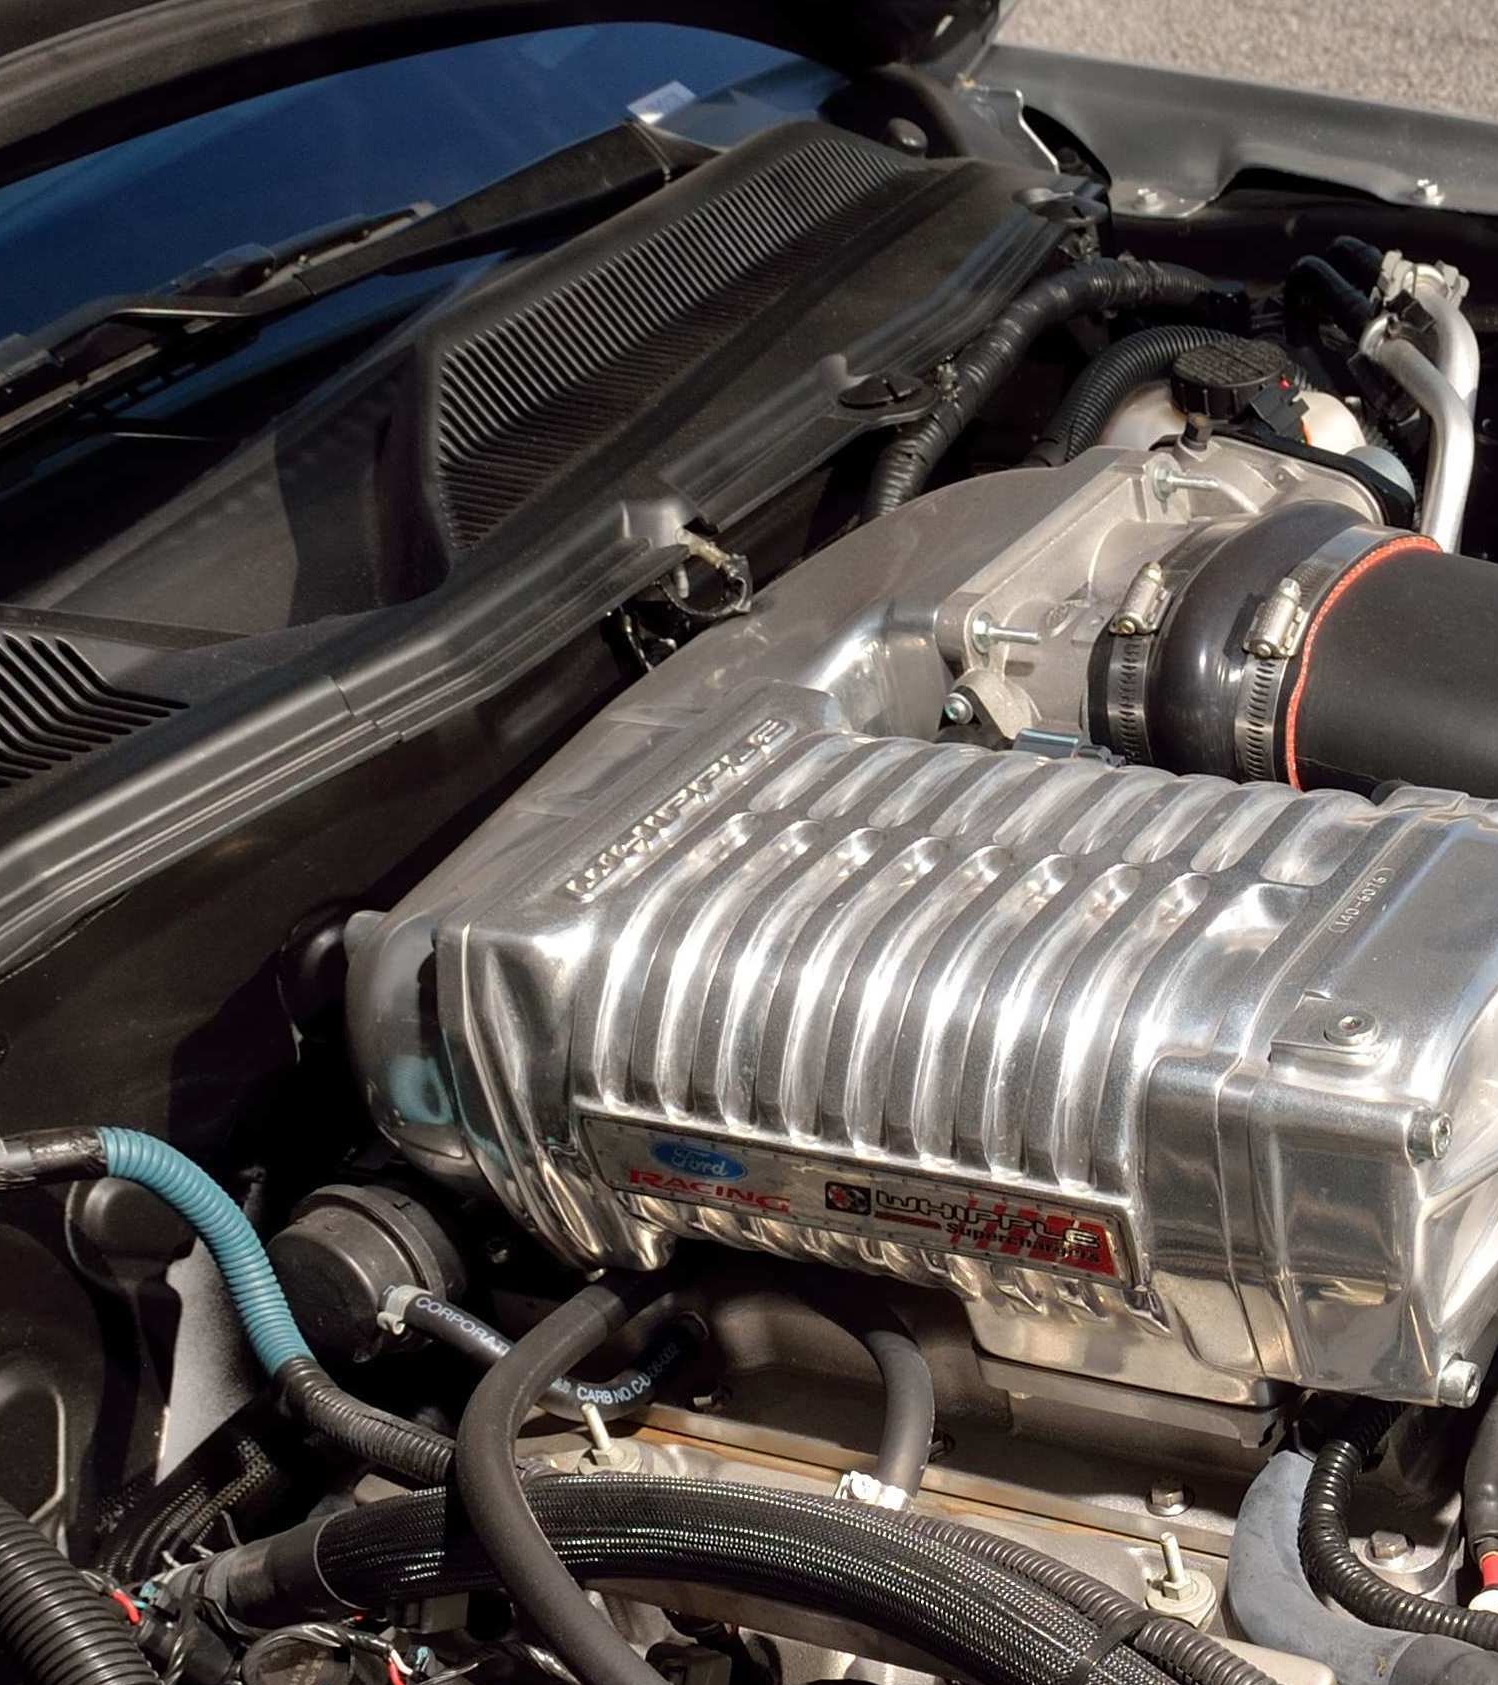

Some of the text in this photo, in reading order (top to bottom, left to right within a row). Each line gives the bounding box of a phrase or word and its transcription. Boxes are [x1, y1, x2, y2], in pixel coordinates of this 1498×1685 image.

[670, 1144, 730, 1179] Ford
[629, 1169, 790, 1214] RACING
[875, 1189, 1100, 1248] WHIPPLE
